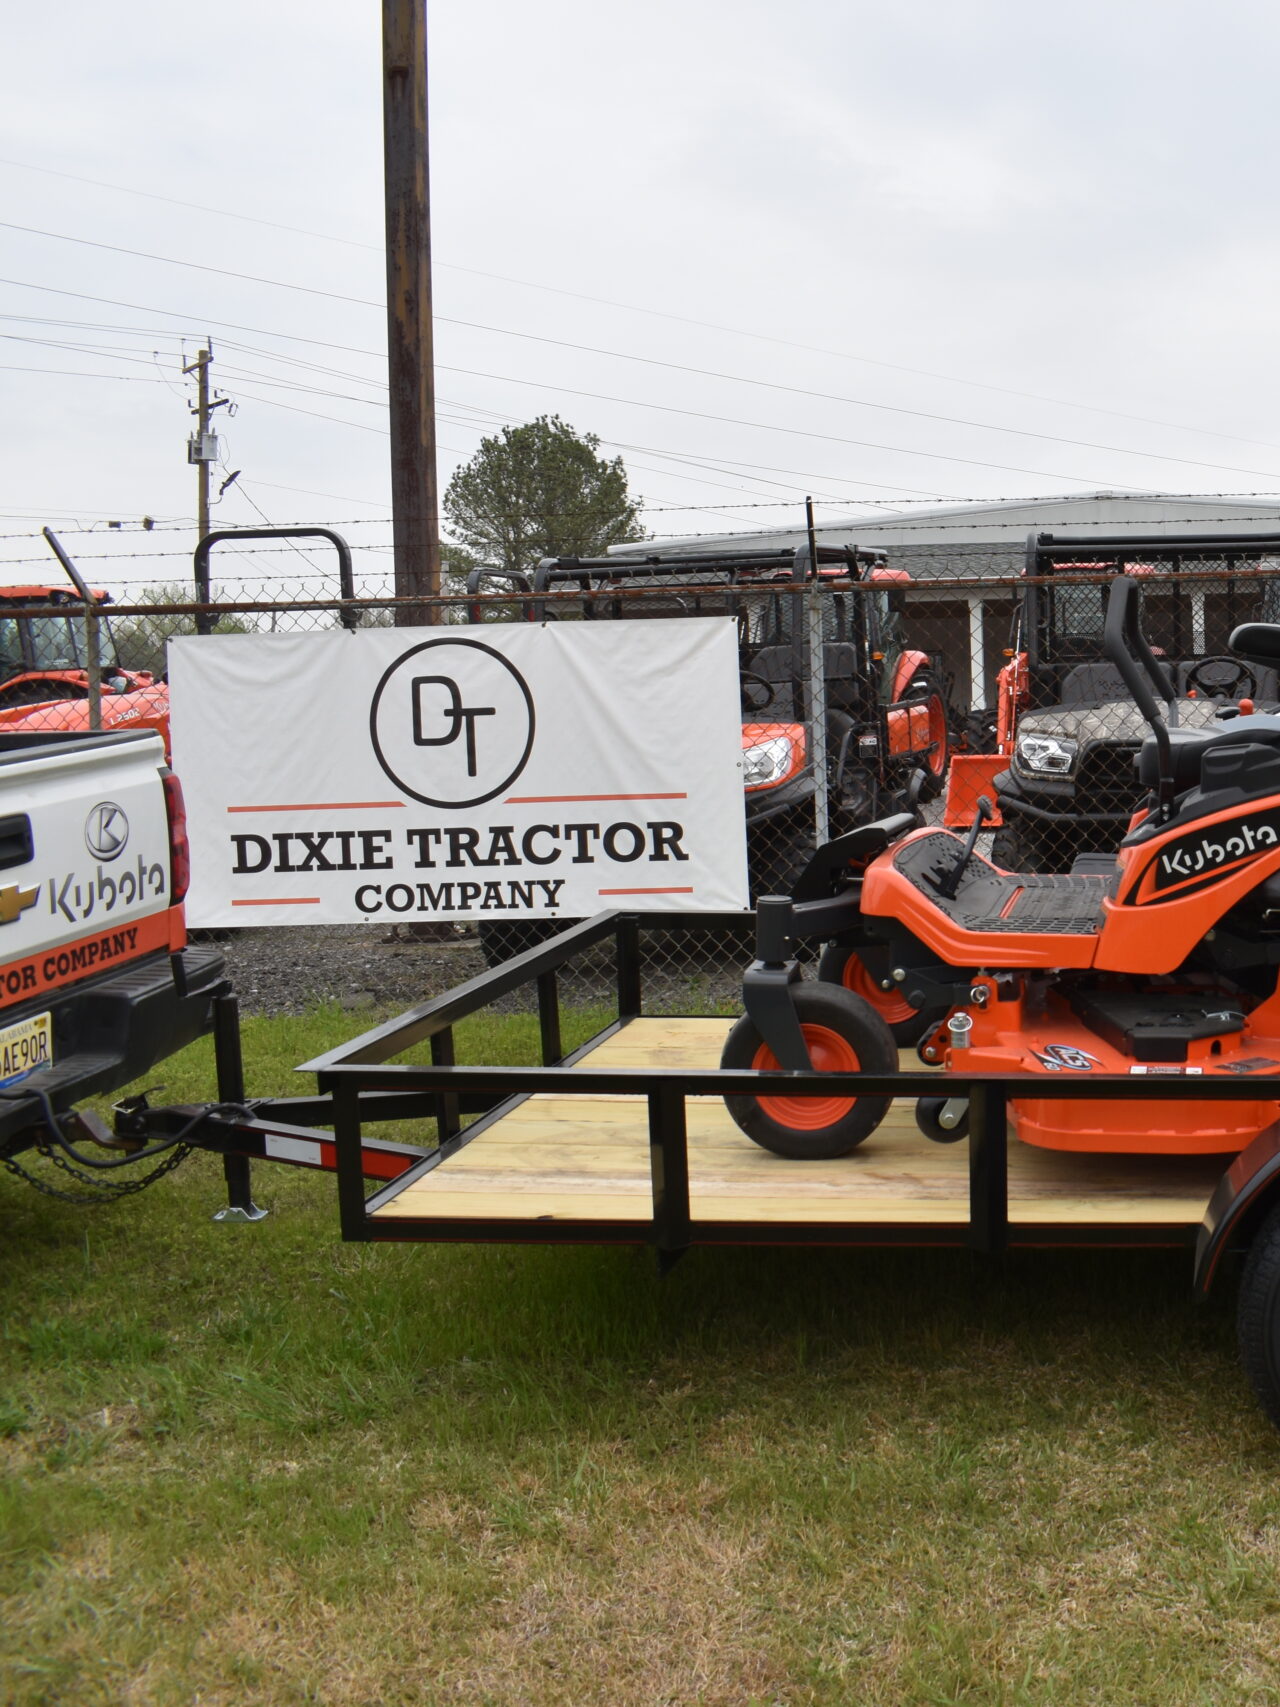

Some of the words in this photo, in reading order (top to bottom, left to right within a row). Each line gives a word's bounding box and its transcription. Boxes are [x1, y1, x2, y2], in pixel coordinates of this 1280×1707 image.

[230, 829, 394, 874] DIXIE
[406, 821, 690, 868] TRACTOR
[1161, 825, 1278, 875] Kubota
[48, 854, 165, 923] Kubota
[354, 879, 566, 914] COMPANY
[43, 927, 138, 982] COMPANY
[0, 1031, 48, 1077] AE90R
